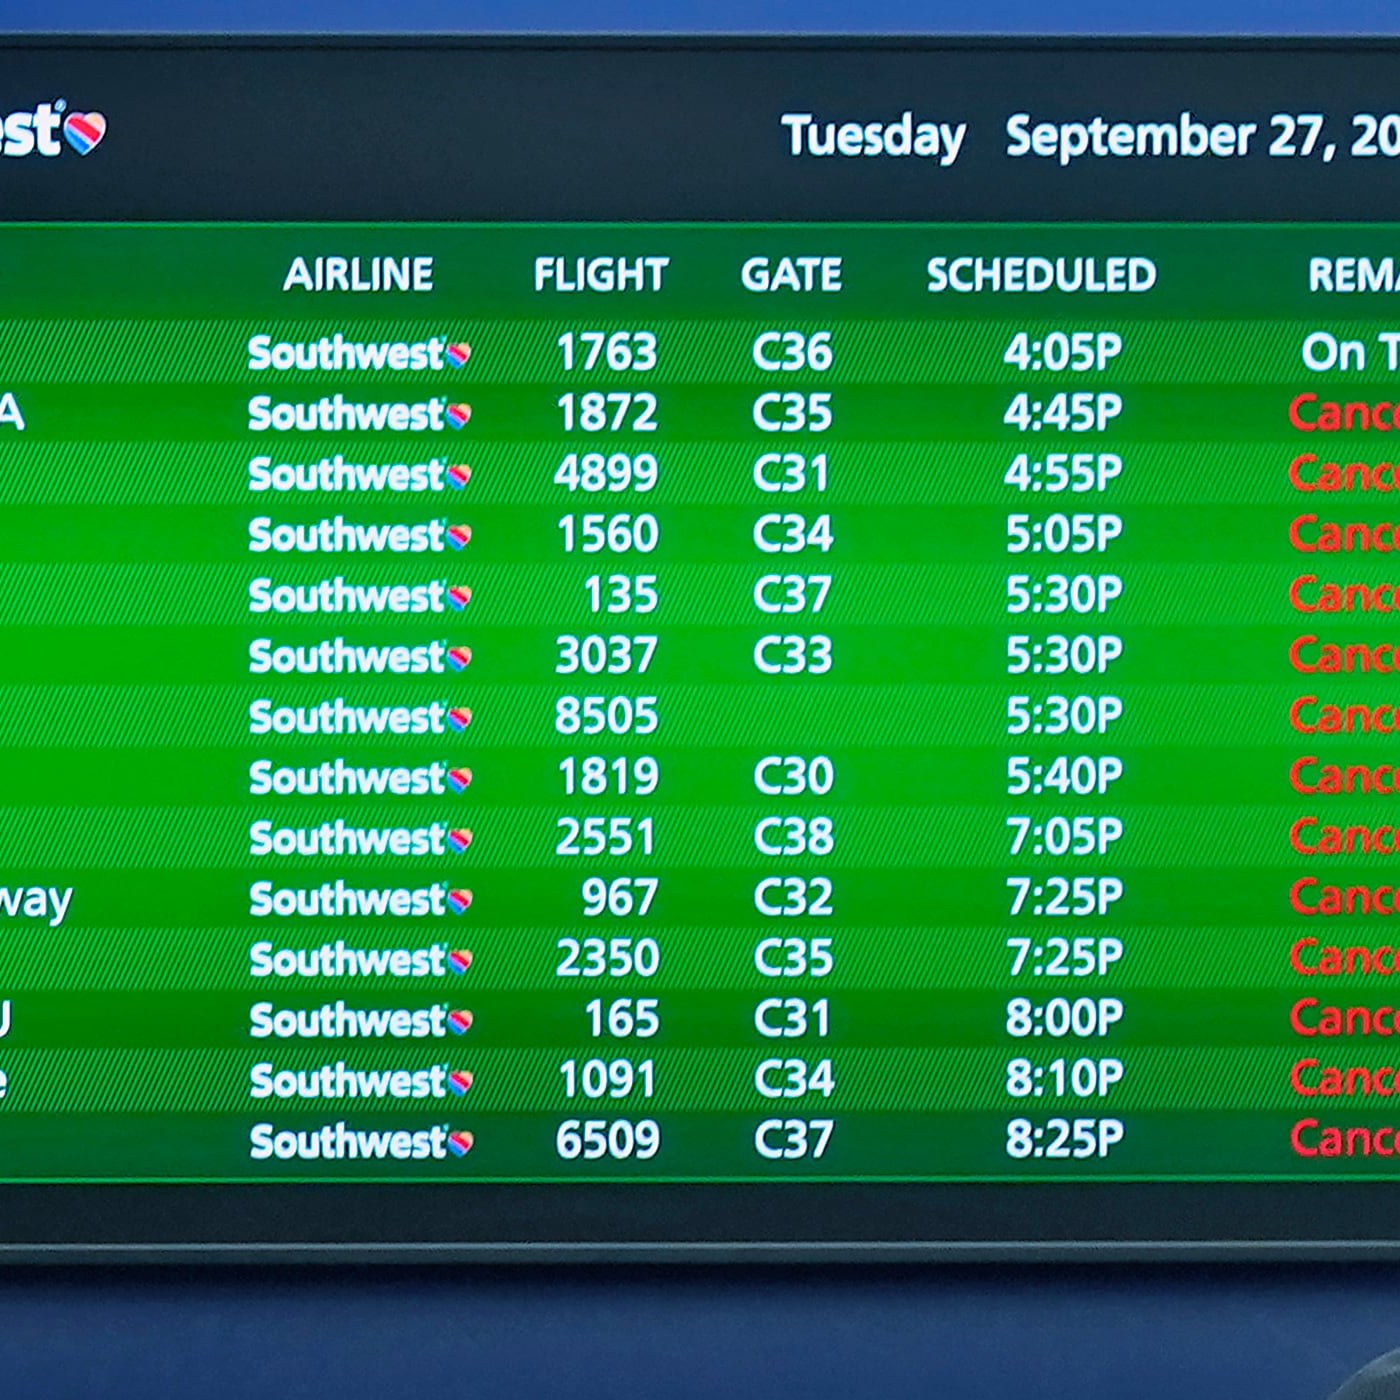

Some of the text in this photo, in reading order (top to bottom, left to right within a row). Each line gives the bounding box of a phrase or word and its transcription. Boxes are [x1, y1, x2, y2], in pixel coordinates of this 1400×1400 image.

[780, 111, 967, 166] Tuesday
[1006, 112, 1257, 166] September
[1269, 114, 1336, 162] 27,
[283, 256, 433, 291] AIRLINE
[535, 257, 670, 291] FLIGHT
[741, 257, 842, 291] GATE
[927, 257, 1157, 292] SCHEDULED
[248, 333, 445, 370] Southwest
[558, 331, 657, 371] 1763
[753, 331, 833, 371] C36
[1003, 332, 1122, 371] 4:05P
[1302, 332, 1365, 371] On
[248, 394, 445, 431] Southwest
[558, 392, 658, 431] 1872
[753, 392, 832, 432] C35
[1003, 393, 1122, 431] 4:45P
[248, 455, 445, 491] Southwest
[553, 453, 658, 492] 4899
[753, 453, 827, 492] C31
[1004, 453, 1123, 492] 4:55P
[248, 515, 445, 552] Southwest
[558, 513, 659, 553] 1560
[753, 513, 834, 553] C34
[1007, 513, 1123, 553] 5:05P
[249, 576, 445, 613] Southwest
[585, 574, 658, 613] 135
[753, 574, 832, 613] C37
[1007, 574, 1123, 613] 5:30P
[249, 637, 445, 673] Southwest
[555, 635, 658, 674] 3037
[753, 635, 832, 674] C33
[1007, 635, 1123, 674] 5:30P
[249, 697, 445, 734] Southwest
[555, 695, 658, 735] 8505
[1007, 695, 1123, 734] 5:30P
[249, 758, 446, 795] Southwest
[559, 756, 659, 795] 1819
[754, 756, 834, 795] C30
[1008, 755, 1123, 795] 5:40P
[249, 819, 446, 856] Southwest
[556, 817, 653, 855] 2551
[754, 816, 834, 855] C38
[1006, 816, 1123, 855] 7:05P
[250, 879, 446, 916] Southwest
[582, 877, 659, 916] 967
[754, 877, 833, 916] C32
[1006, 877, 1123, 916] 7:25P
[250, 940, 446, 977] Southwest
[556, 938, 660, 977] 2350
[754, 937, 833, 977] C35
[1007, 937, 1123, 976] 7:25P
[250, 1000, 446, 1038] Southwest
[586, 998, 659, 1037] 165
[755, 998, 828, 1037] C31
[1006, 997, 1123, 1037] 8:00P
[250, 1061, 446, 1098] Southwest
[560, 1059, 653, 1098] 1091
[755, 1059, 836, 1098] C34
[1006, 1058, 1124, 1097] 8:10P
[250, 1121, 446, 1159] Southwest
[556, 1119, 660, 1159] 6509
[755, 1119, 834, 1159] C37
[1006, 1118, 1124, 1158] 8:25P
